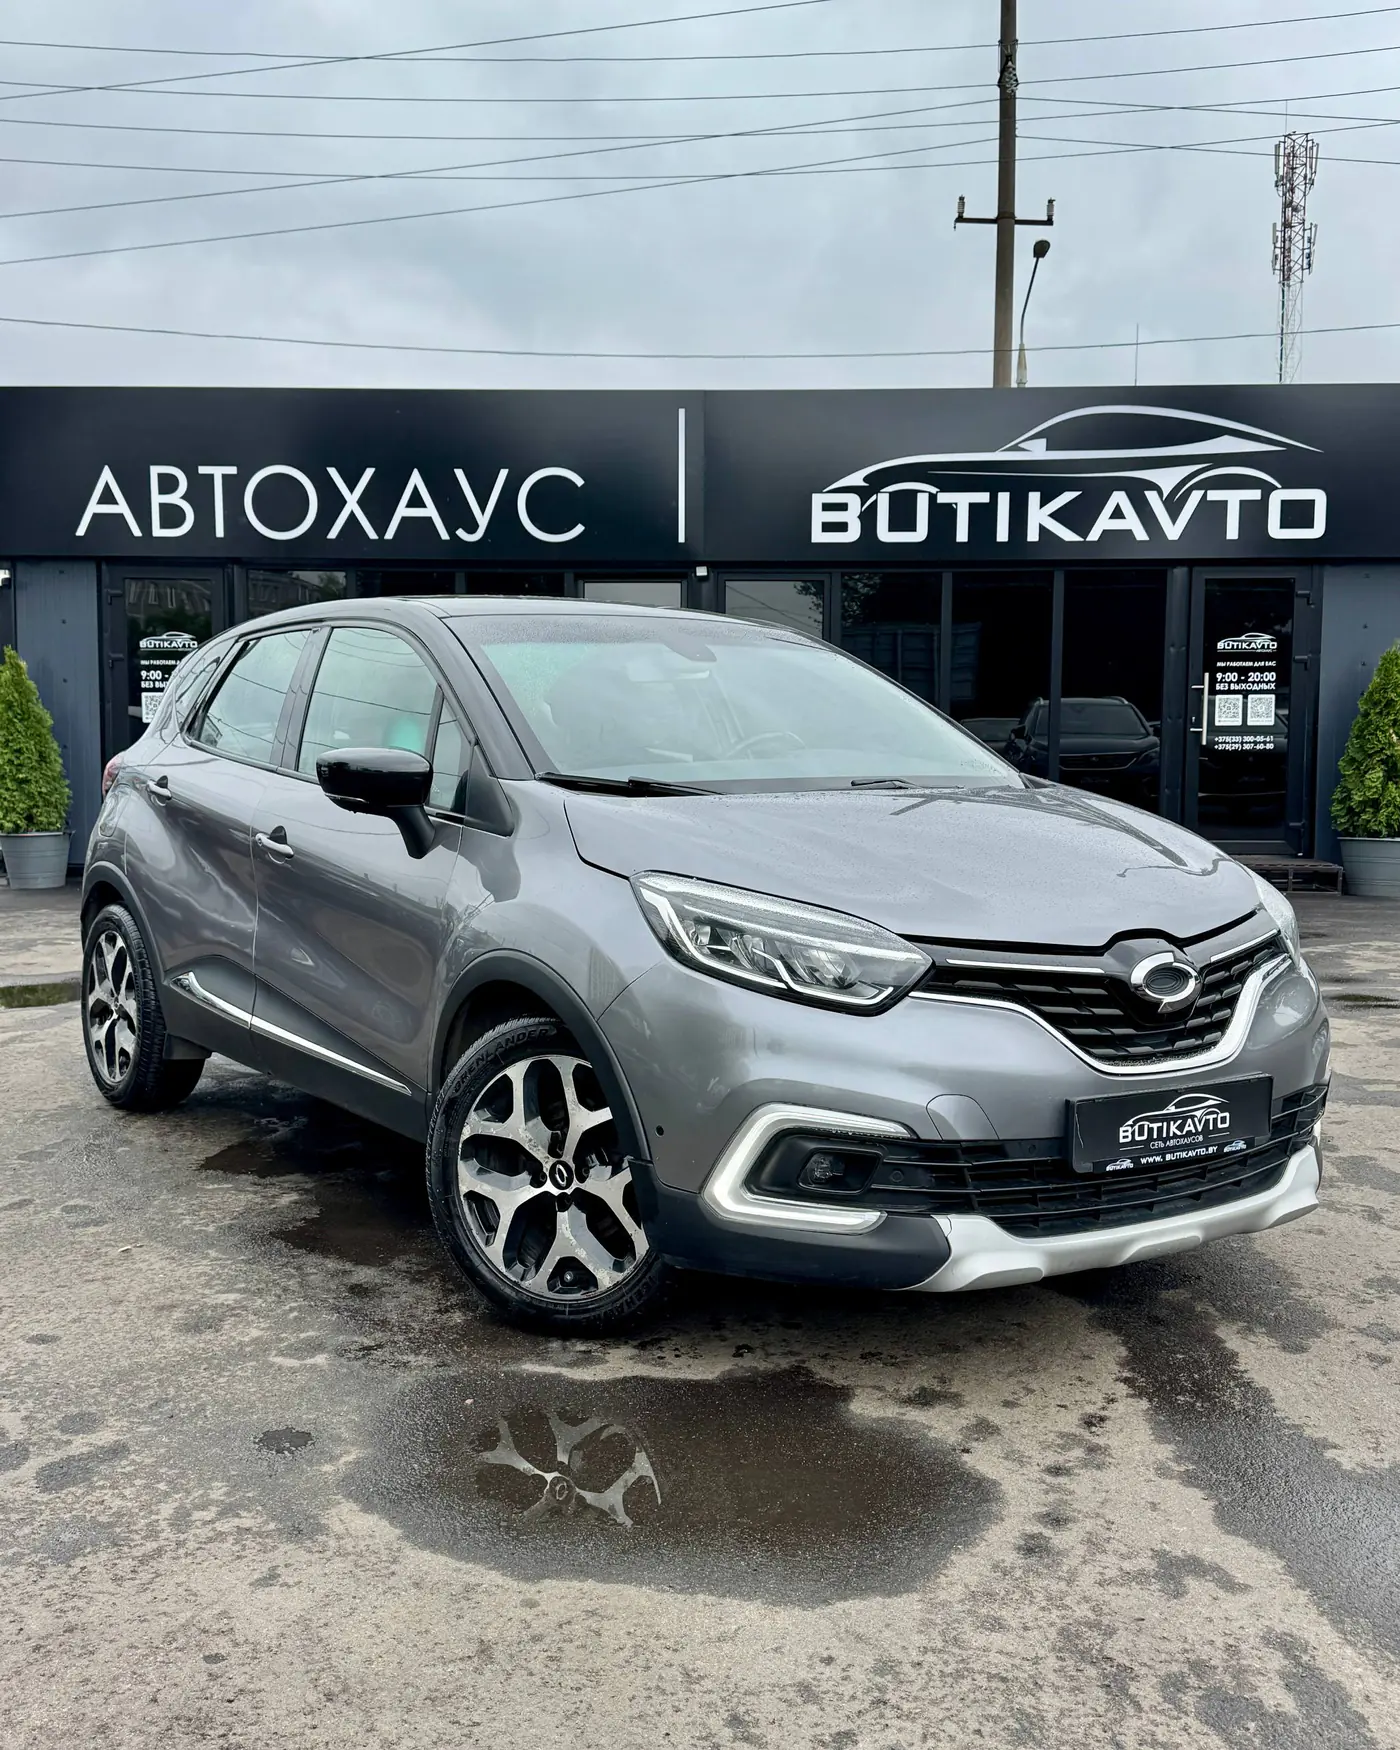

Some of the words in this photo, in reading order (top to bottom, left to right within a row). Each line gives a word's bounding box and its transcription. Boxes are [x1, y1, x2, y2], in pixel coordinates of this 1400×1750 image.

[75, 464, 586, 543] АВТОХАУС
[811, 487, 1327, 544] BUTIKAVTO
[1217, 641, 1277, 649] BUTIKAVTO
[141, 670, 162, 680] 9:00
[1216, 672, 1238, 682] 9:00
[1247, 672, 1276, 681] 20:00
[1119, 1112, 1230, 1143] BUTIKAVTO
[1150, 1139, 1165, 1149] СЕТЬ
[1166, 1135, 1203, 1147] АВТОХАУСОВ
[1140, 1156, 1163, 1164] WWW.
[1165, 1146, 1218, 1161] BUTIKAVTO.BY
